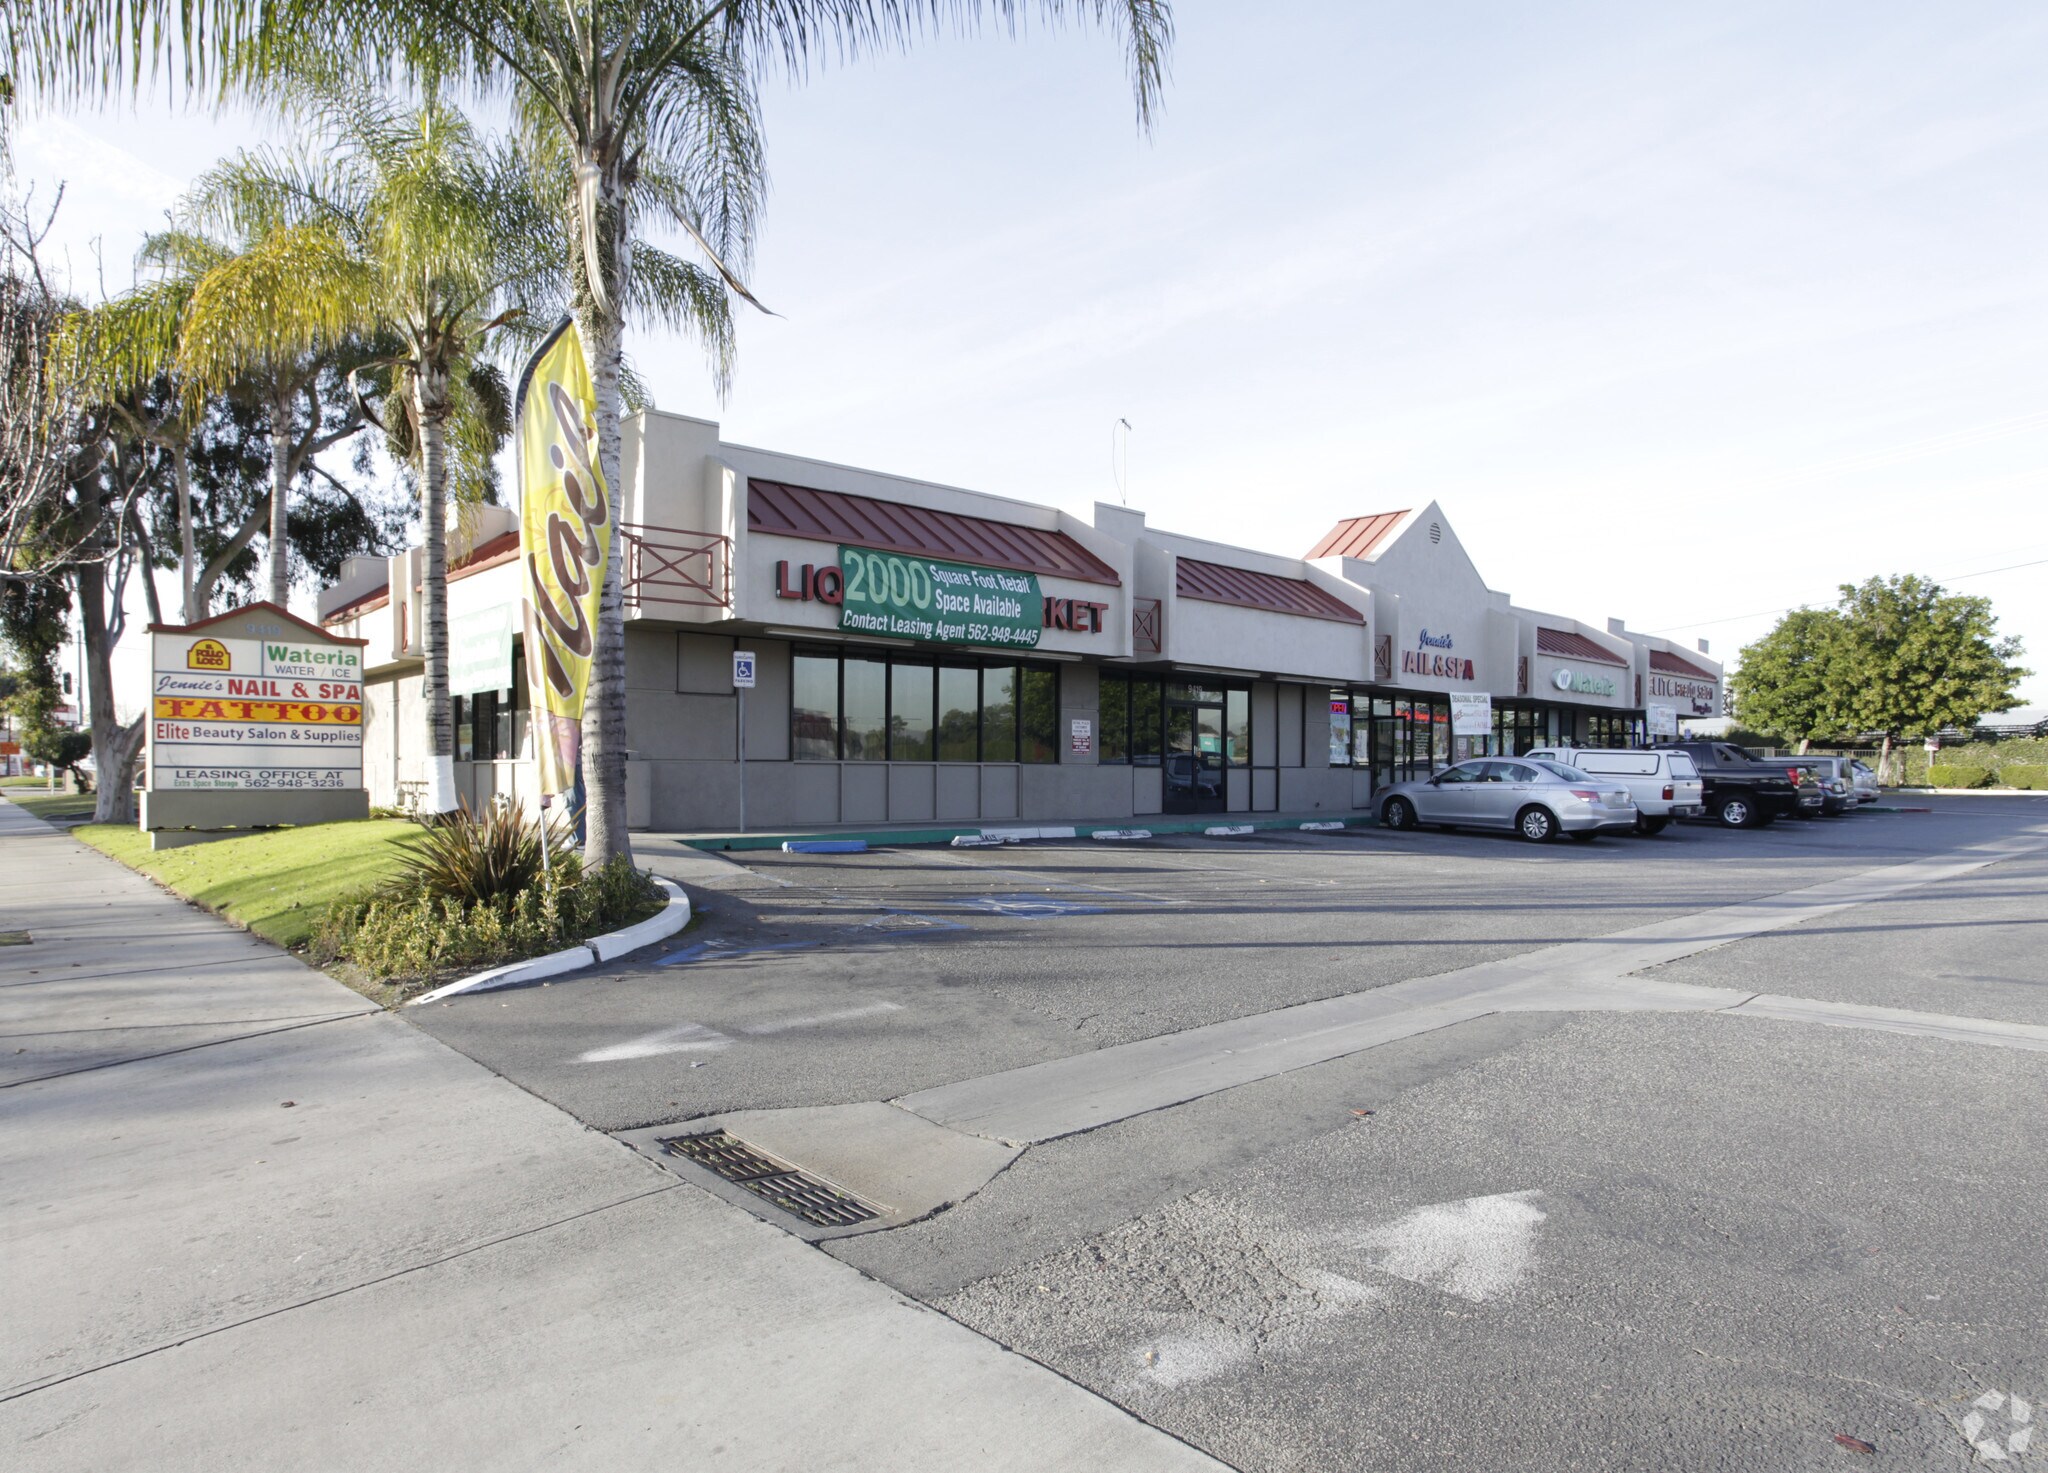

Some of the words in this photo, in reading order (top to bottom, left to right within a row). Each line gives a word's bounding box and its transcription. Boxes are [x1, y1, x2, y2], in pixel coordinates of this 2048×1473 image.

[844, 550, 931, 610] 2000
[930, 565, 971, 588] Square
[971, 571, 998, 590] Foot
[997, 574, 1031, 594] Retail
[936, 589, 970, 615] Space
[973, 593, 1022, 618] Available
[843, 609, 888, 631] Contact
[891, 614, 933, 639] Leasing
[935, 620, 967, 641] Agent
[968, 623, 1039, 645] 562-948-4445
[1419, 628, 1453, 650] Jennie's
[197, 657, 224, 666] LOCO
[267, 645, 357, 666] Wateria
[275, 665, 315, 676] WATER
[331, 668, 351, 678] ICE
[1433, 655, 1445, 677] &
[1446, 656, 1474, 681] SPA
[156, 675, 224, 692] Jennie's
[228, 679, 281, 697] NAIL
[292, 682, 309, 698] &
[319, 683, 360, 700] SPA
[158, 699, 361, 722] TATTOO
[157, 723, 190, 740] Elite
[193, 726, 244, 742] Beauty
[248, 728, 287, 740] Salon
[290, 730, 300, 740] &
[304, 729, 360, 743] Supplies
[174, 779, 191, 787] Extra
[193, 779, 212, 788] Space
[214, 779, 238, 788] Storage
[245, 779, 344, 788] 562-948-3236
[176, 770, 251, 779] LEASING
[259, 771, 317, 779] OFFICE
[324, 771, 343, 779] AT
